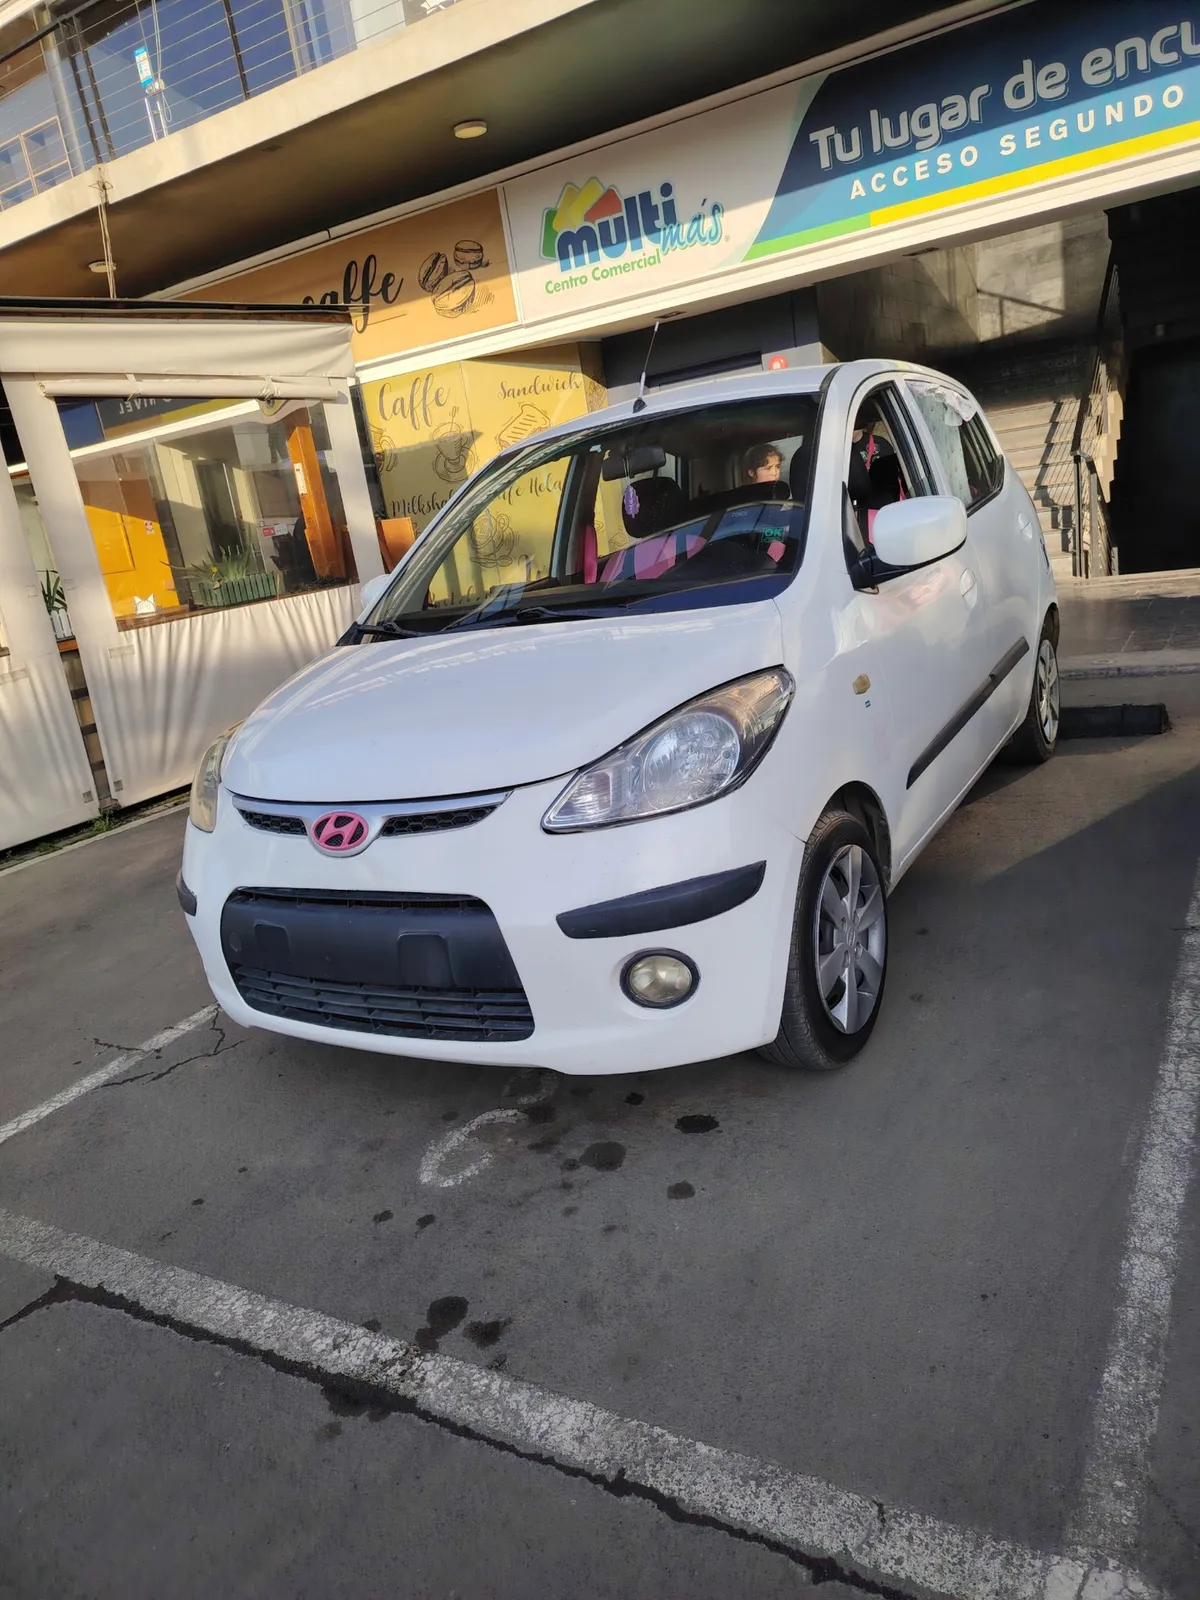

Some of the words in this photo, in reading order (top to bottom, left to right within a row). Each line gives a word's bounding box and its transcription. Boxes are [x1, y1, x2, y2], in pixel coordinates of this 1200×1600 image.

[809, 125, 863, 171] Tu
[869, 84, 992, 152] lugar
[1003, 58, 1069, 111] de
[850, 145, 978, 200] ACCESO
[1000, 85, 1184, 156] SEGUNDO
[557, 181, 678, 273] multi
[659, 197, 725, 255] más
[302, 253, 405, 335] ffe
[545, 274, 588, 295] Centro
[591, 249, 661, 282] Comercial
[378, 372, 450, 431] Caffe
[497, 370, 583, 400] Sandwich
[764, 528, 783, 537] OK
